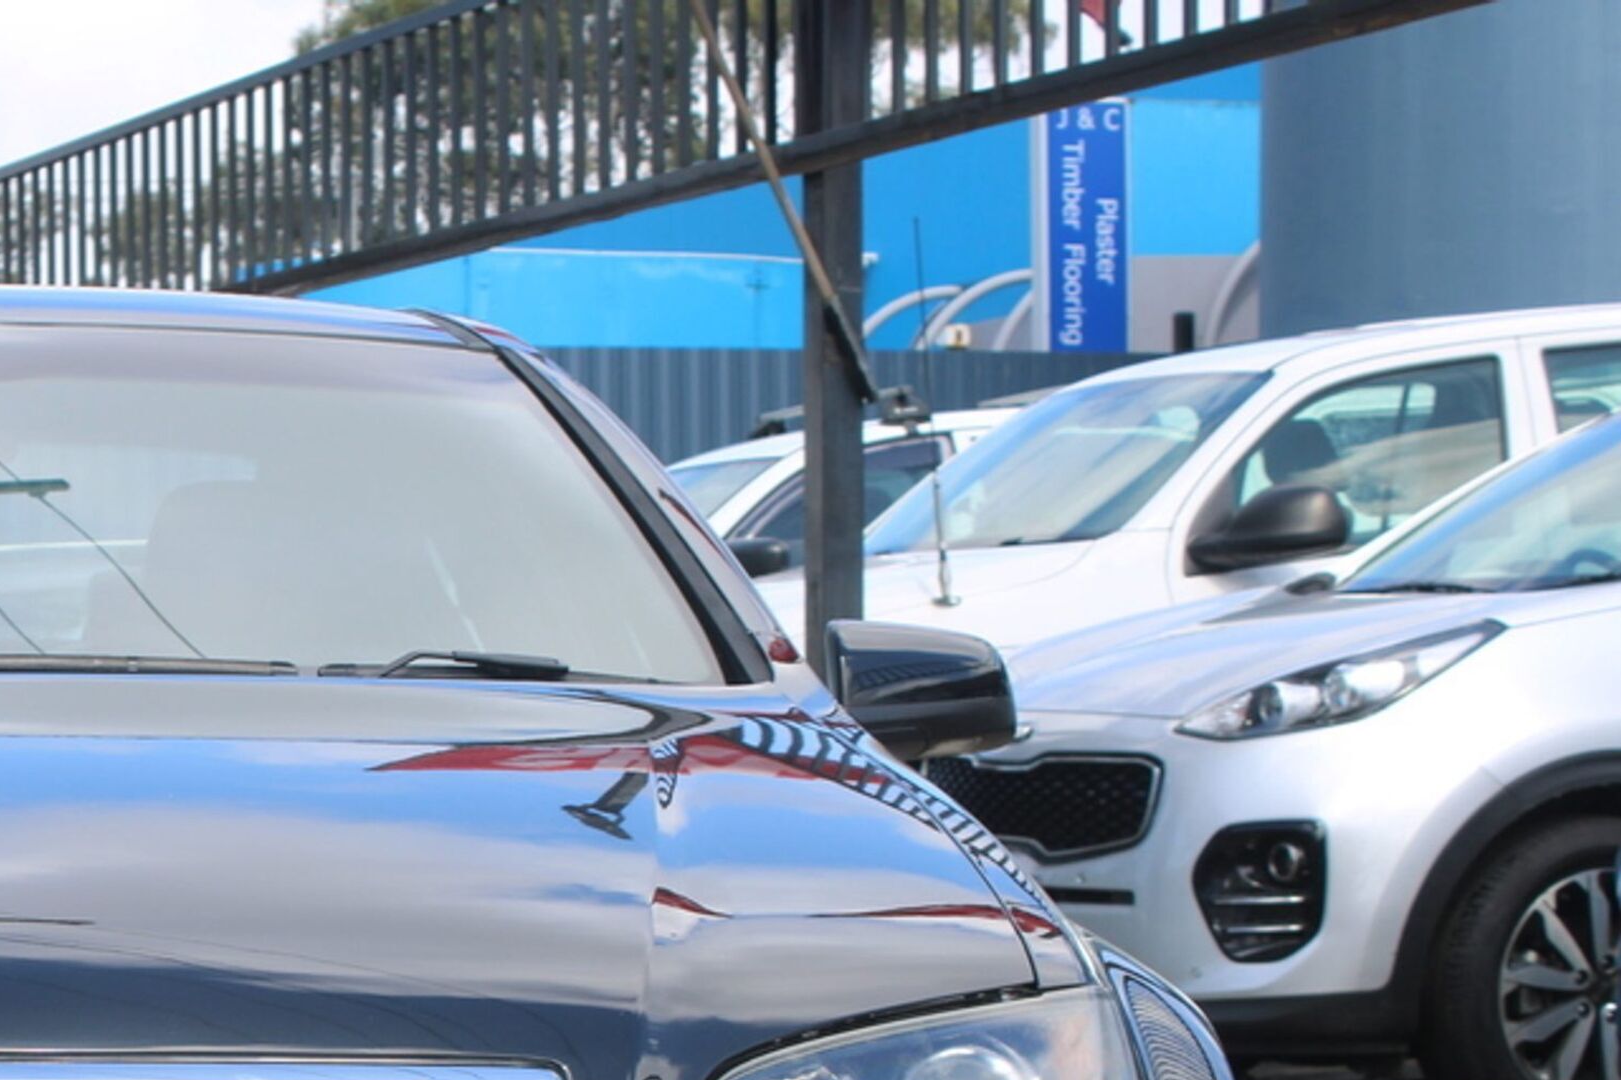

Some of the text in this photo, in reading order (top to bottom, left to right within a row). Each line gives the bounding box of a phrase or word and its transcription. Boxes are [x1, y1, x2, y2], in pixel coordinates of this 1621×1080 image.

[1077, 107, 1095, 130] &
[1103, 108, 1121, 131] C
[1059, 140, 1085, 346] Timber Flooring
[1095, 198, 1118, 286] Plaster
